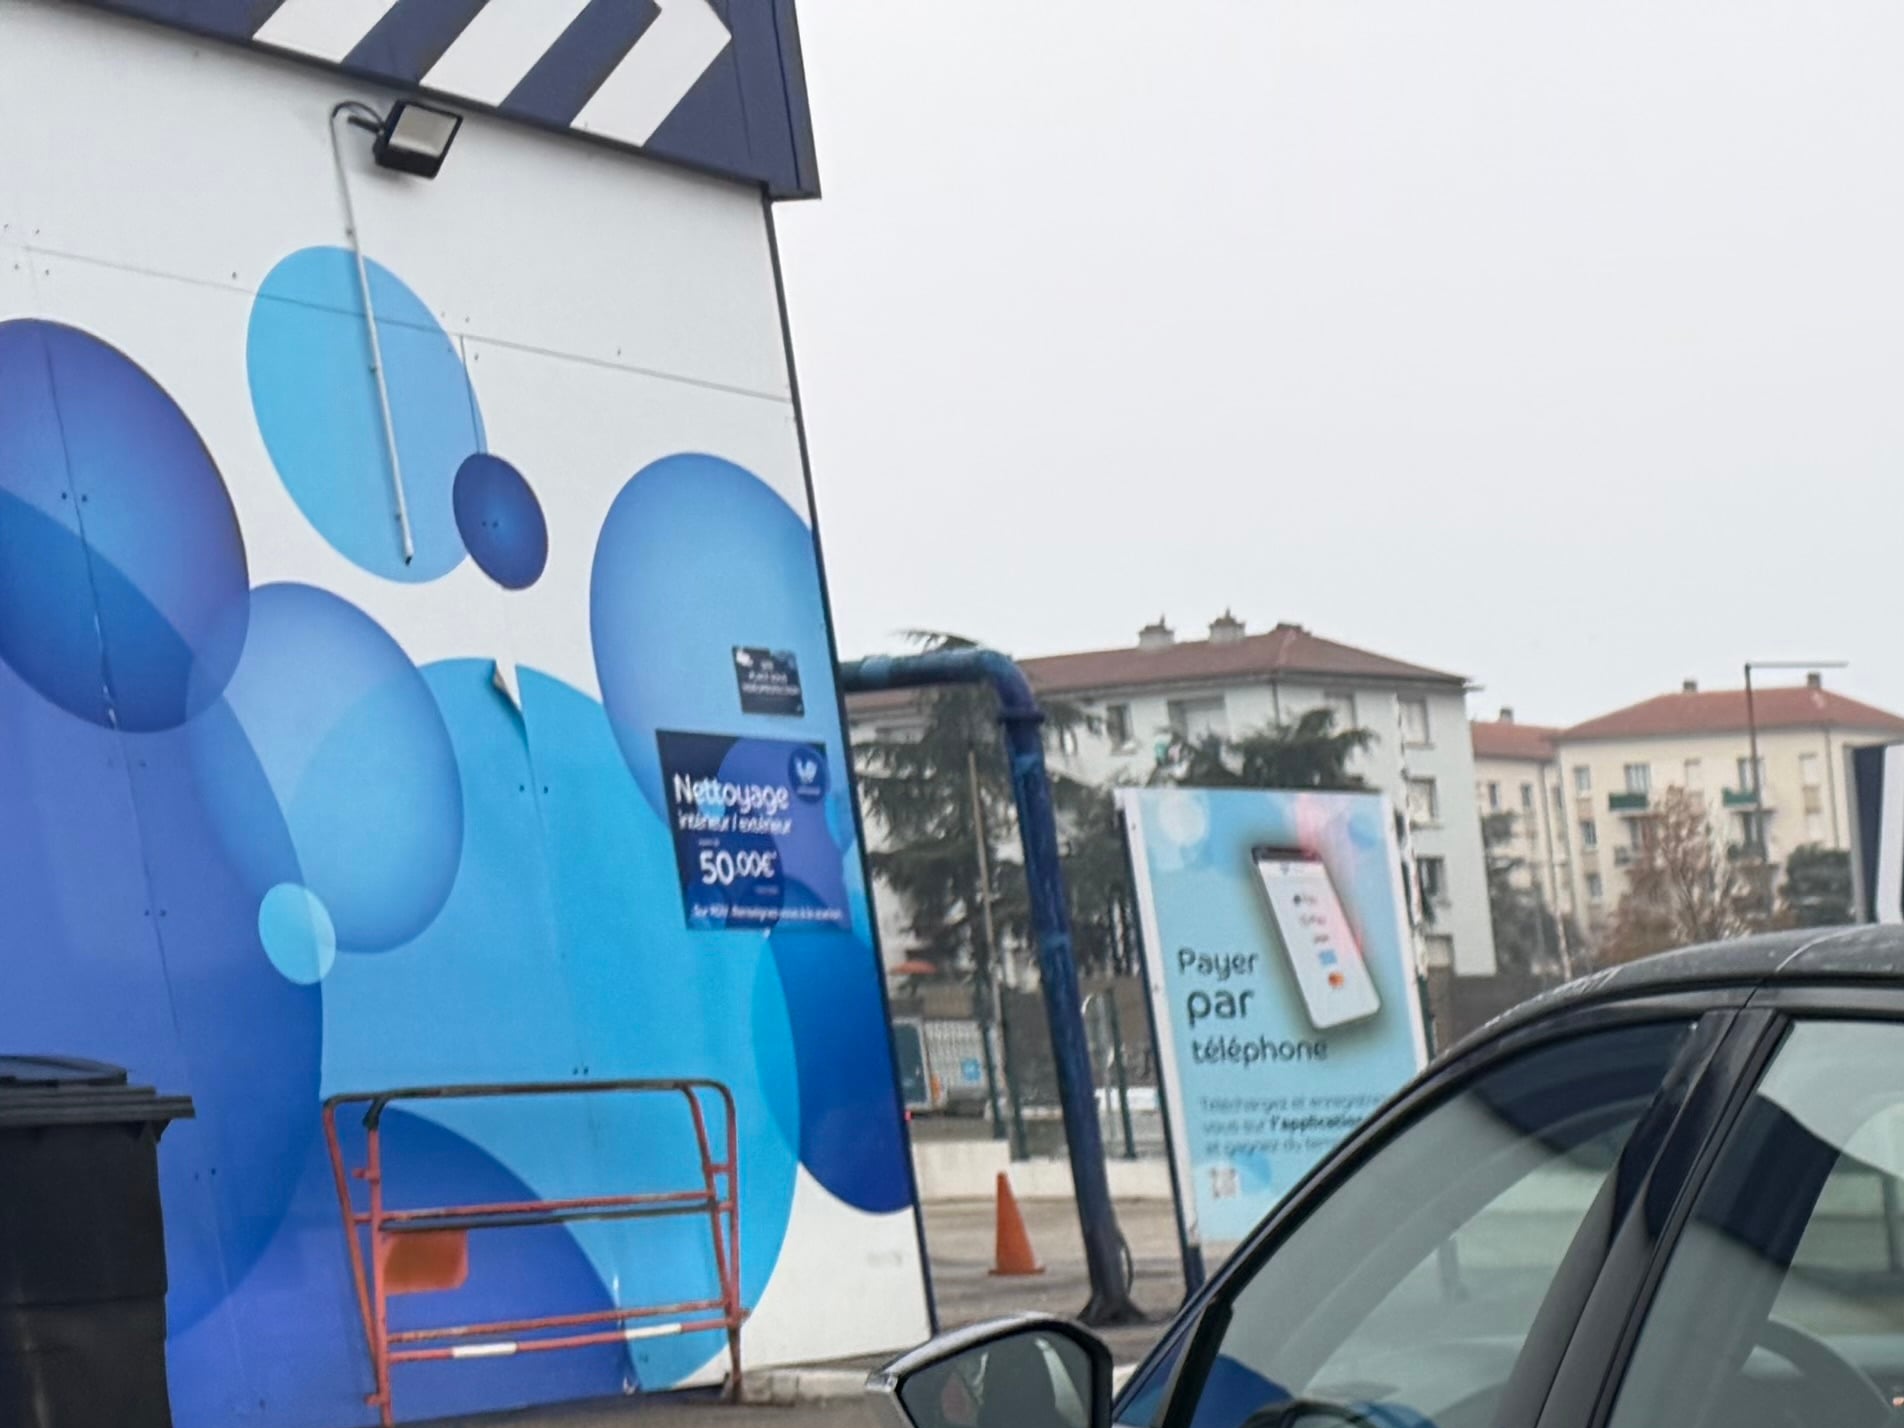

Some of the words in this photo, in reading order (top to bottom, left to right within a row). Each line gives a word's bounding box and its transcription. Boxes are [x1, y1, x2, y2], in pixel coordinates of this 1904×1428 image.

[673, 772, 790, 816] Nettoyage
[1178, 947, 1259, 982] Payer
[1186, 988, 1255, 1029] par
[1191, 1033, 1330, 1069] téléphone
